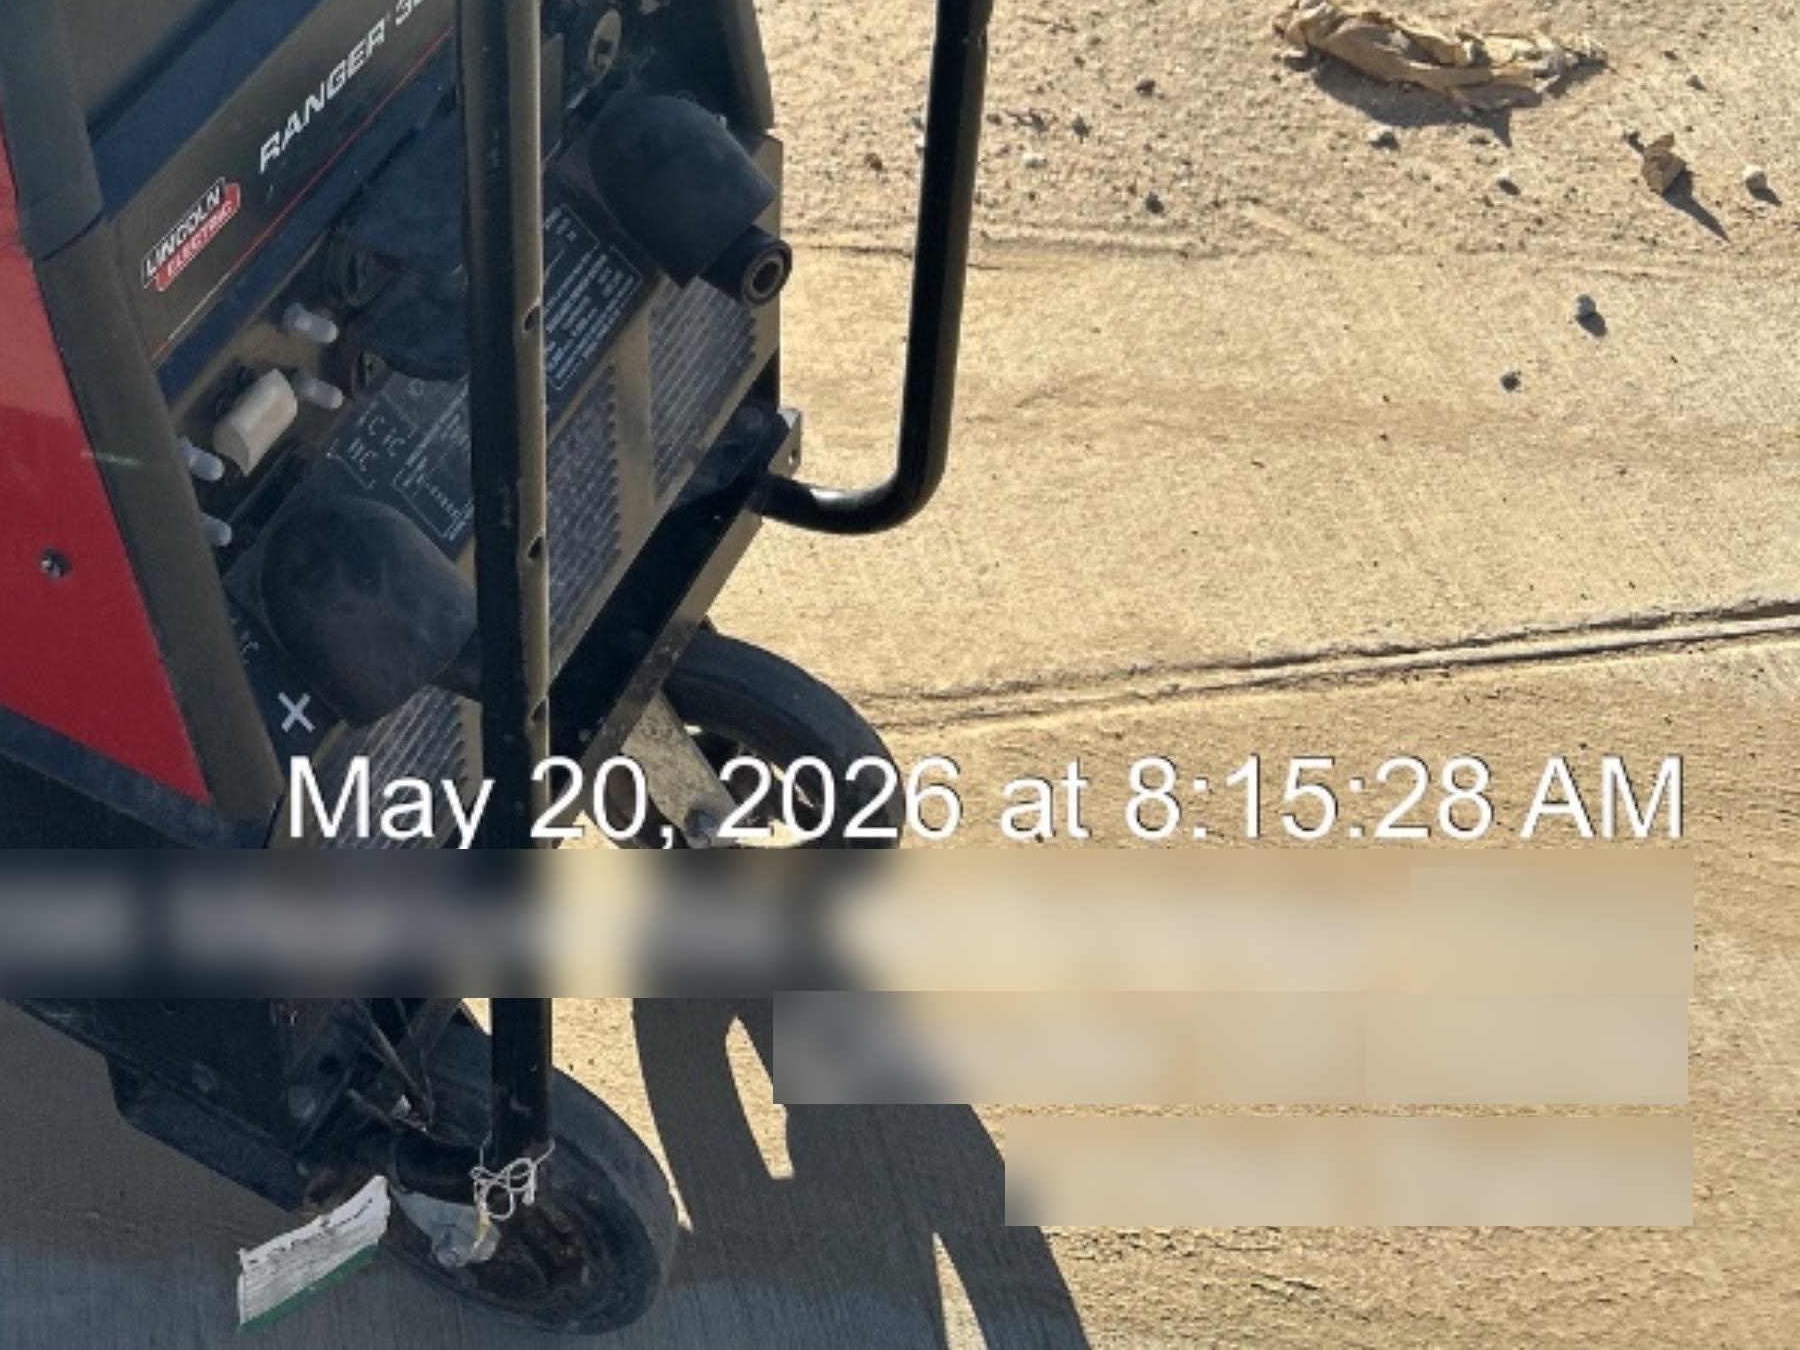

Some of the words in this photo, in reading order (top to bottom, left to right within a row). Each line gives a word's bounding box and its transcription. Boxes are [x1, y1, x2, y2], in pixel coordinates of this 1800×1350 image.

[259, 17, 387, 175] RANGER
[145, 184, 221, 279] LINCOLN
[167, 200, 234, 277] ELECTRIC
